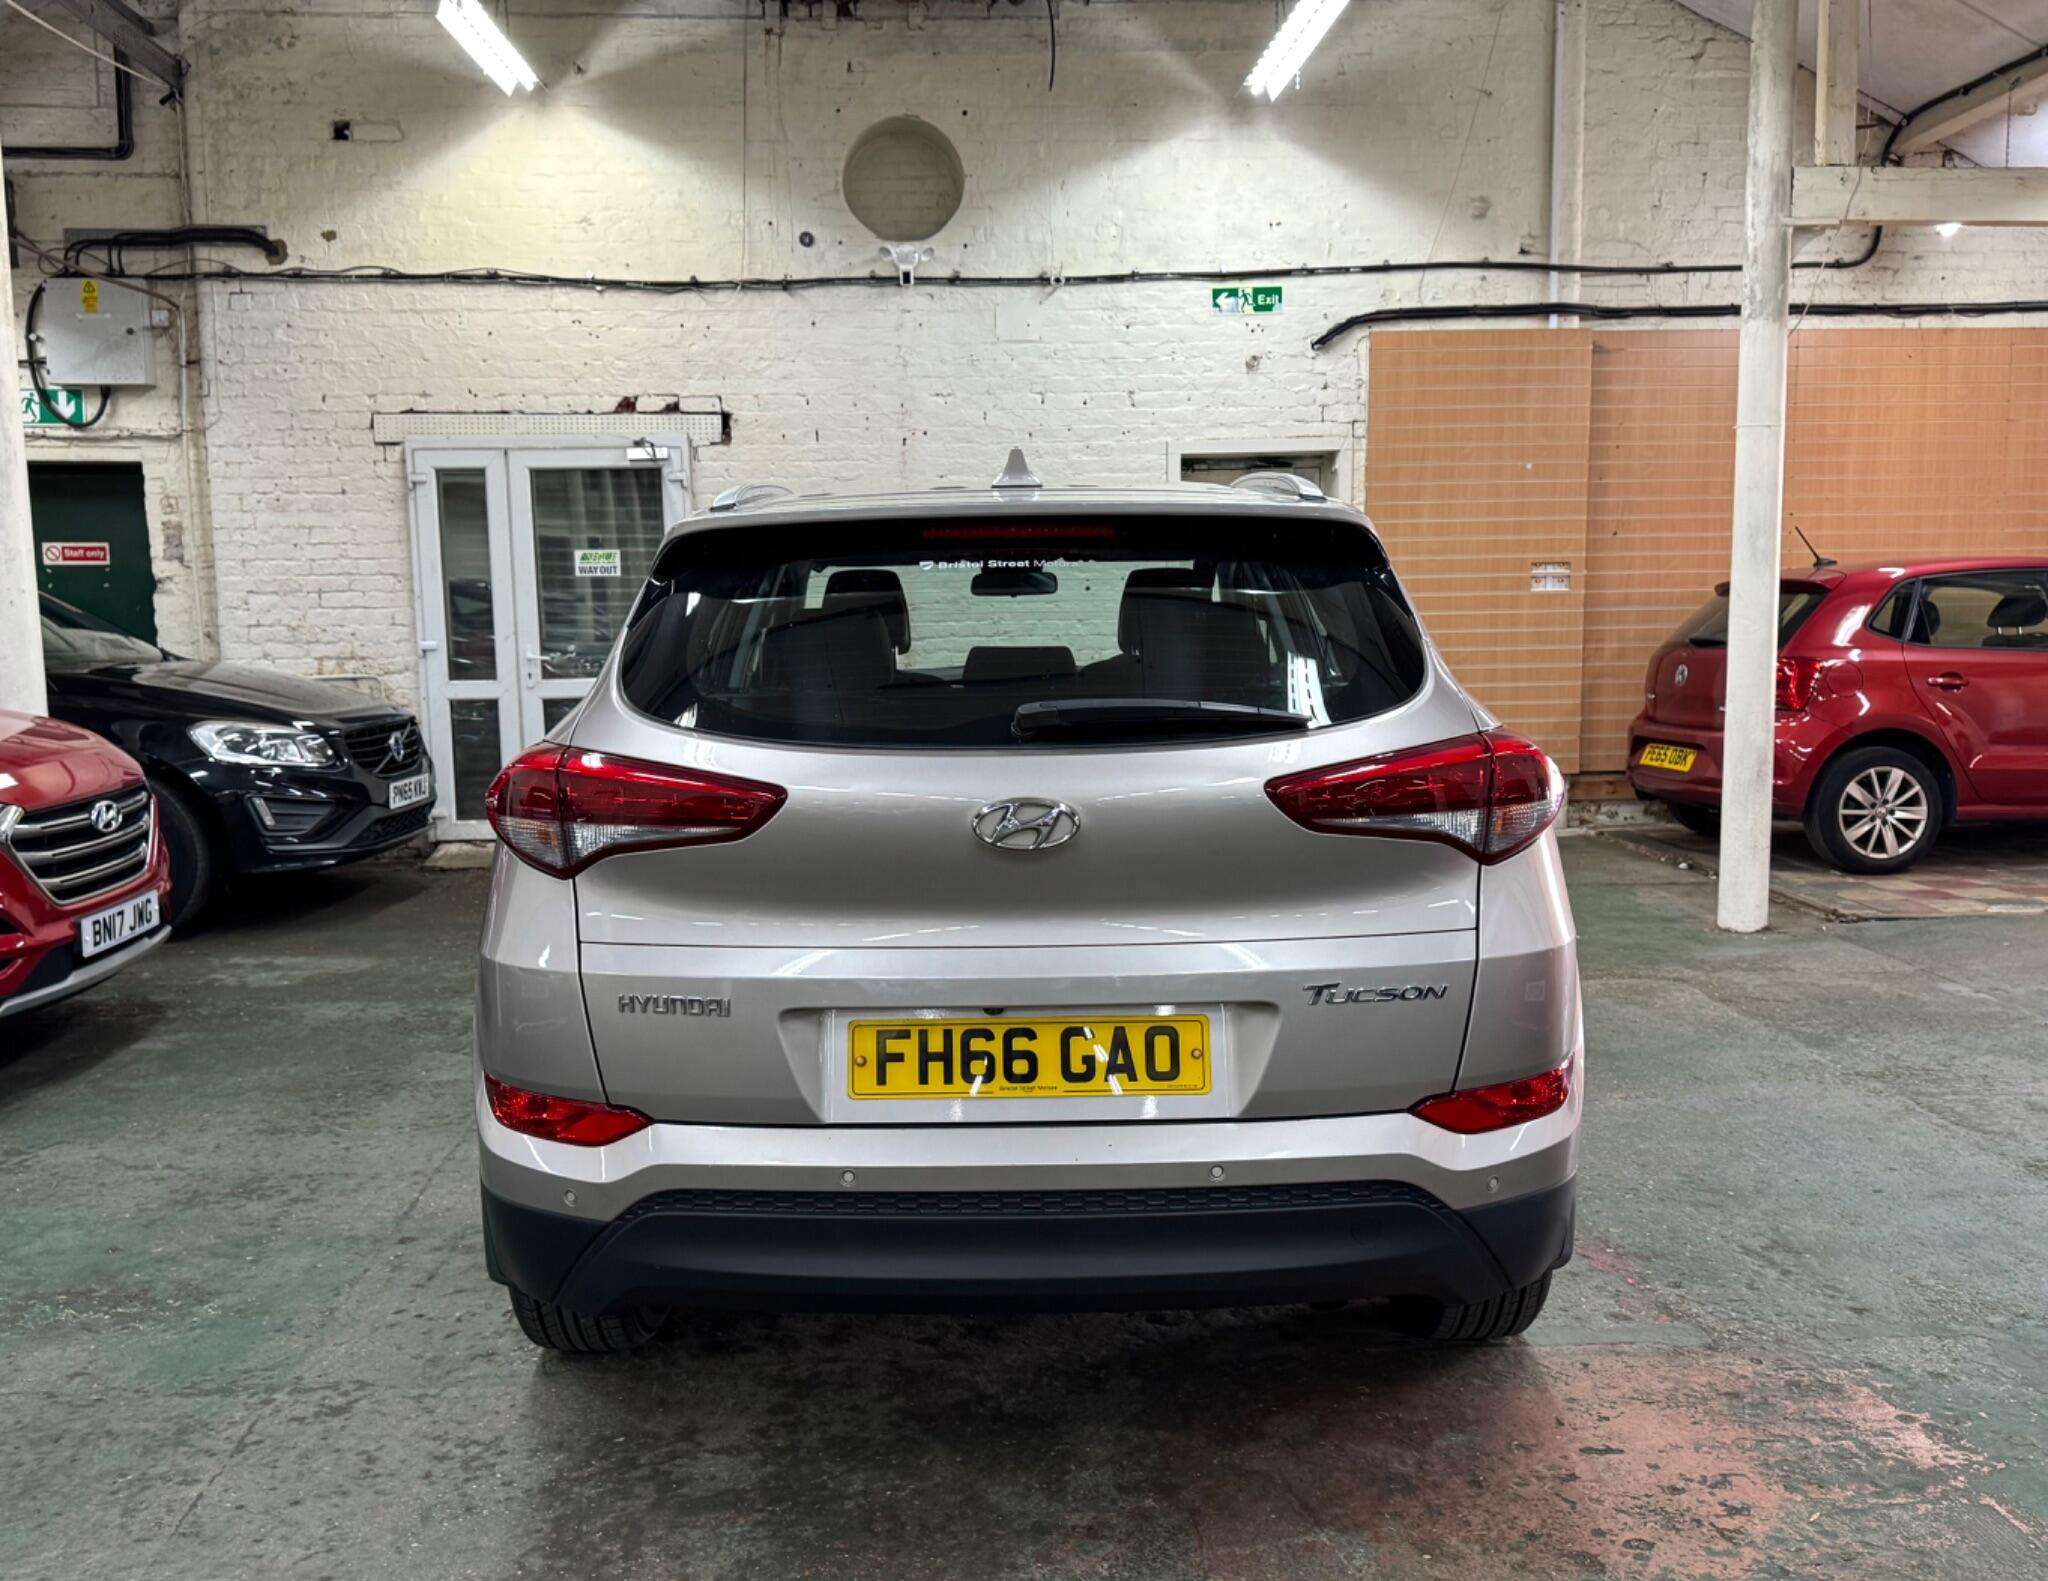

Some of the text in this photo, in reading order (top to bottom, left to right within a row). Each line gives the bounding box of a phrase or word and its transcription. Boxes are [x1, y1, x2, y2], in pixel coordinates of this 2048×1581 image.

[1257, 294, 1280, 306] Exit
[64, 548, 105, 561] Staff only
[578, 566, 617, 575] WAY OUT
[938, 560, 984, 569] Bristol
[987, 559, 1030, 568] Street
[93, 909, 124, 947] BN17
[618, 993, 731, 1017] HYUNDAI
[875, 1025, 1180, 1086] FH66 GAO
